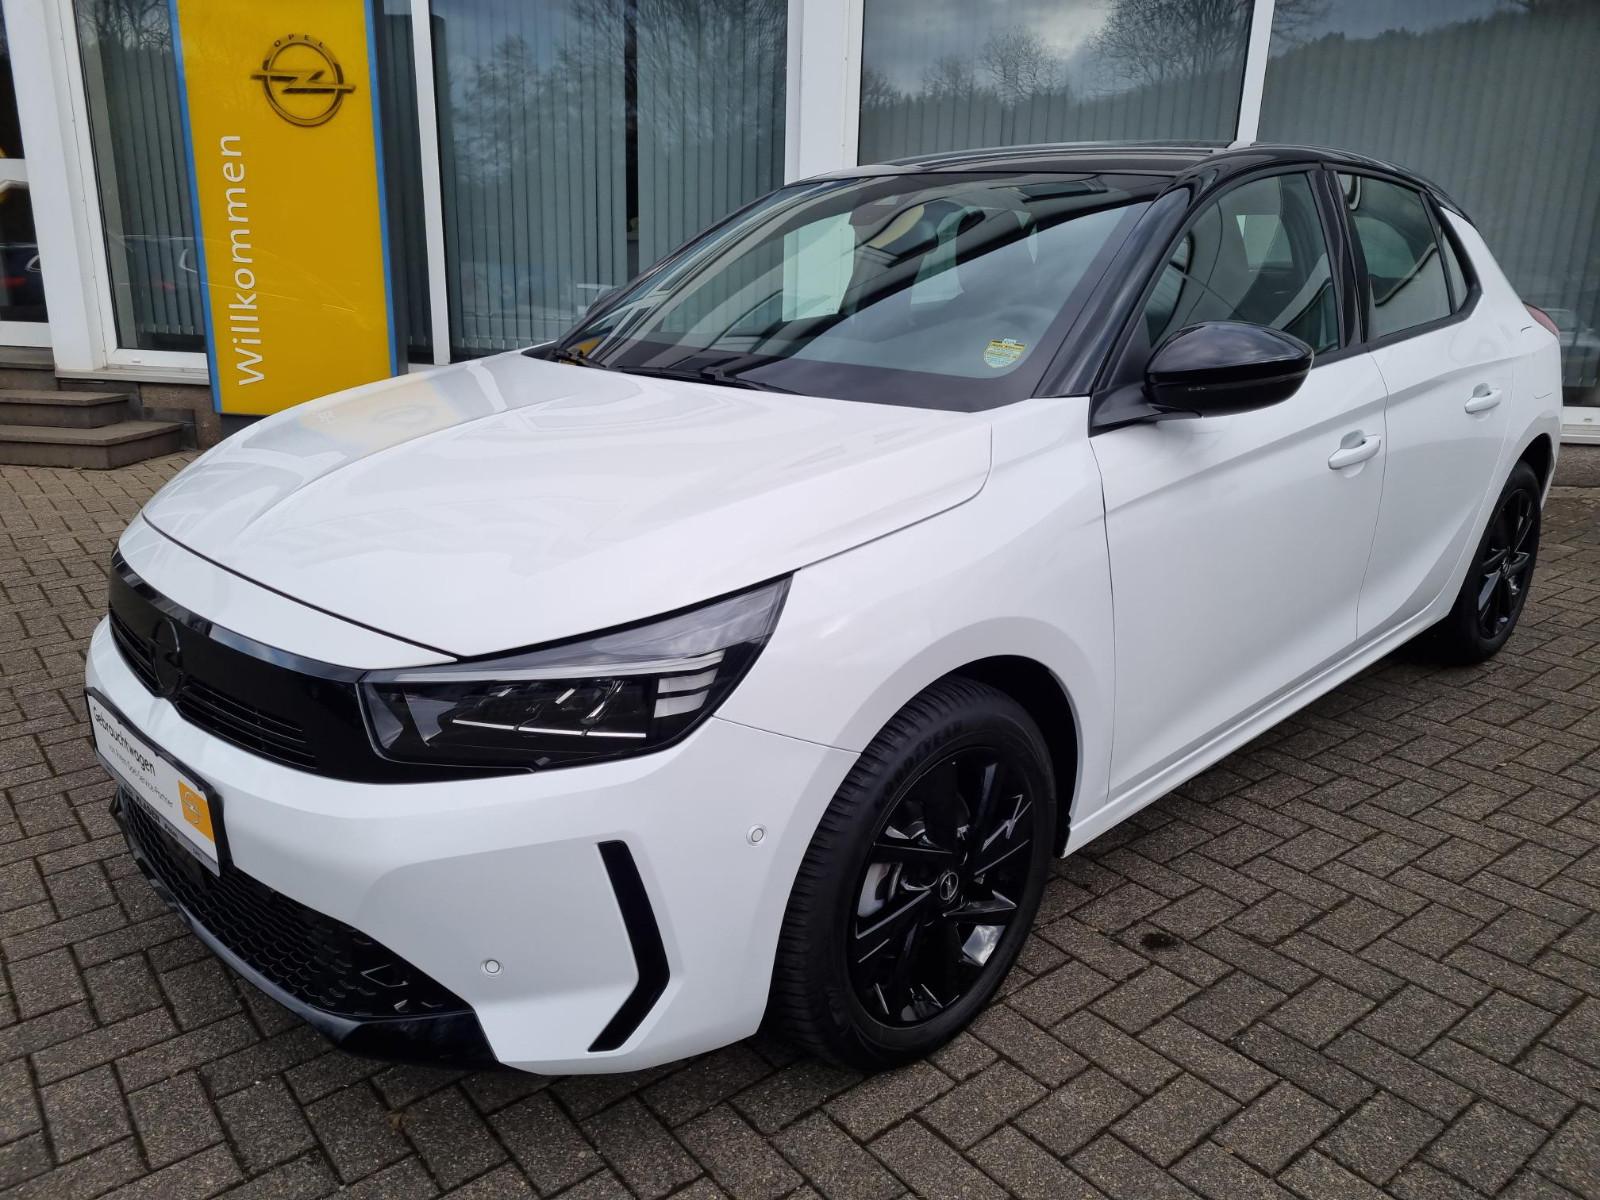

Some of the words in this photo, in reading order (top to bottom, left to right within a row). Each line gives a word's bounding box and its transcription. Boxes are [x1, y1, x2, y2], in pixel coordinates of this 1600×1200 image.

[274, 34, 325, 48] OPEL
[220, 135, 264, 385] Willkommen
[93, 705, 156, 776] Gebrauchtwagen
